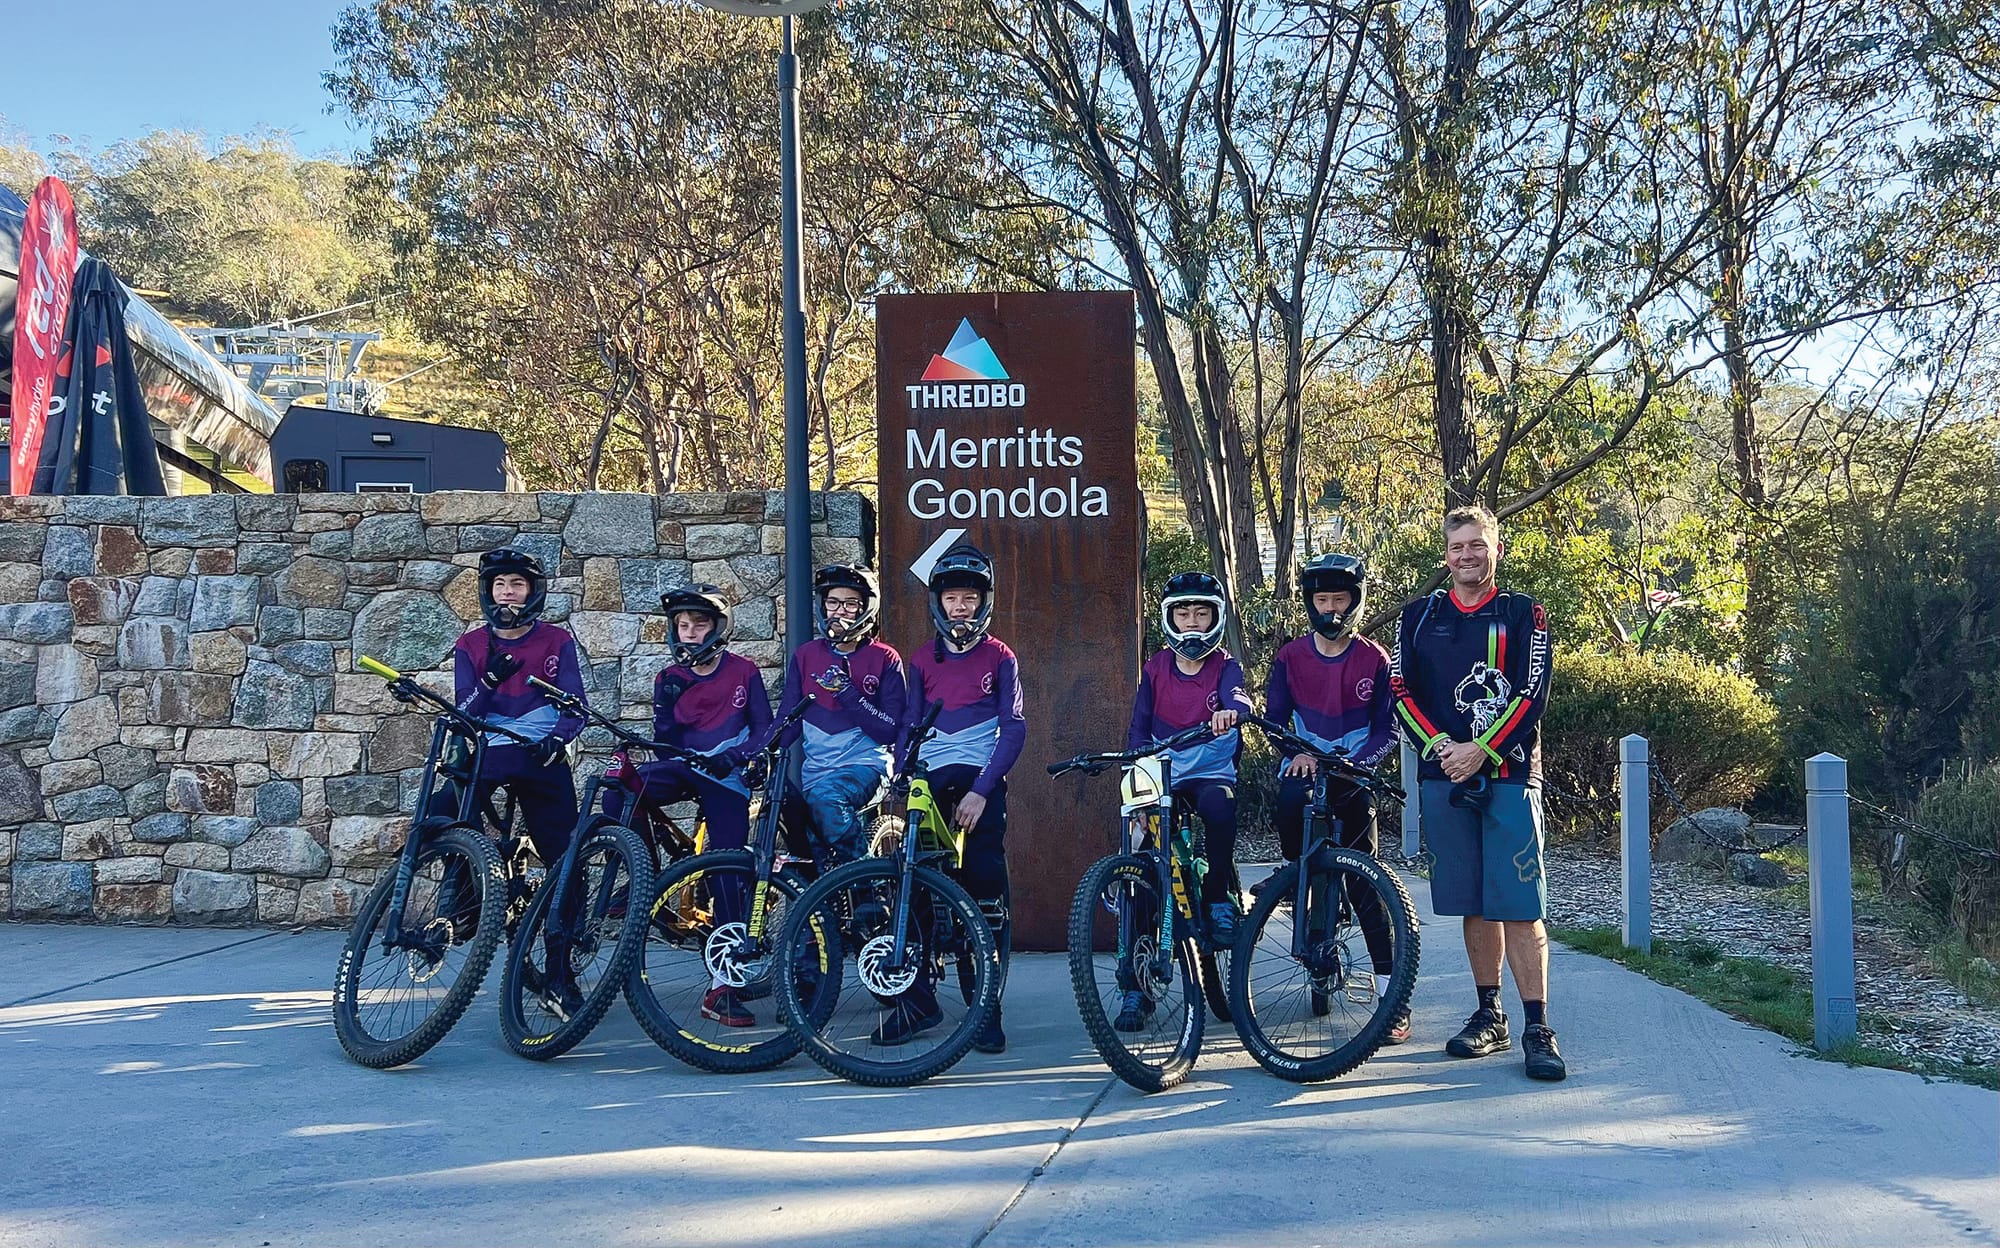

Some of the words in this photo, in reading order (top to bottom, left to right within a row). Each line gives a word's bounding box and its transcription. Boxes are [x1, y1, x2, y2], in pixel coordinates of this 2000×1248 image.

[25, 246, 55, 360] red
[905, 383, 1026, 409] THREDBO
[905, 427, 1084, 469] Merritts
[907, 477, 1109, 519] Gondola
[1130, 766, 1153, 798] L
[338, 950, 353, 1003] MAXXIS
